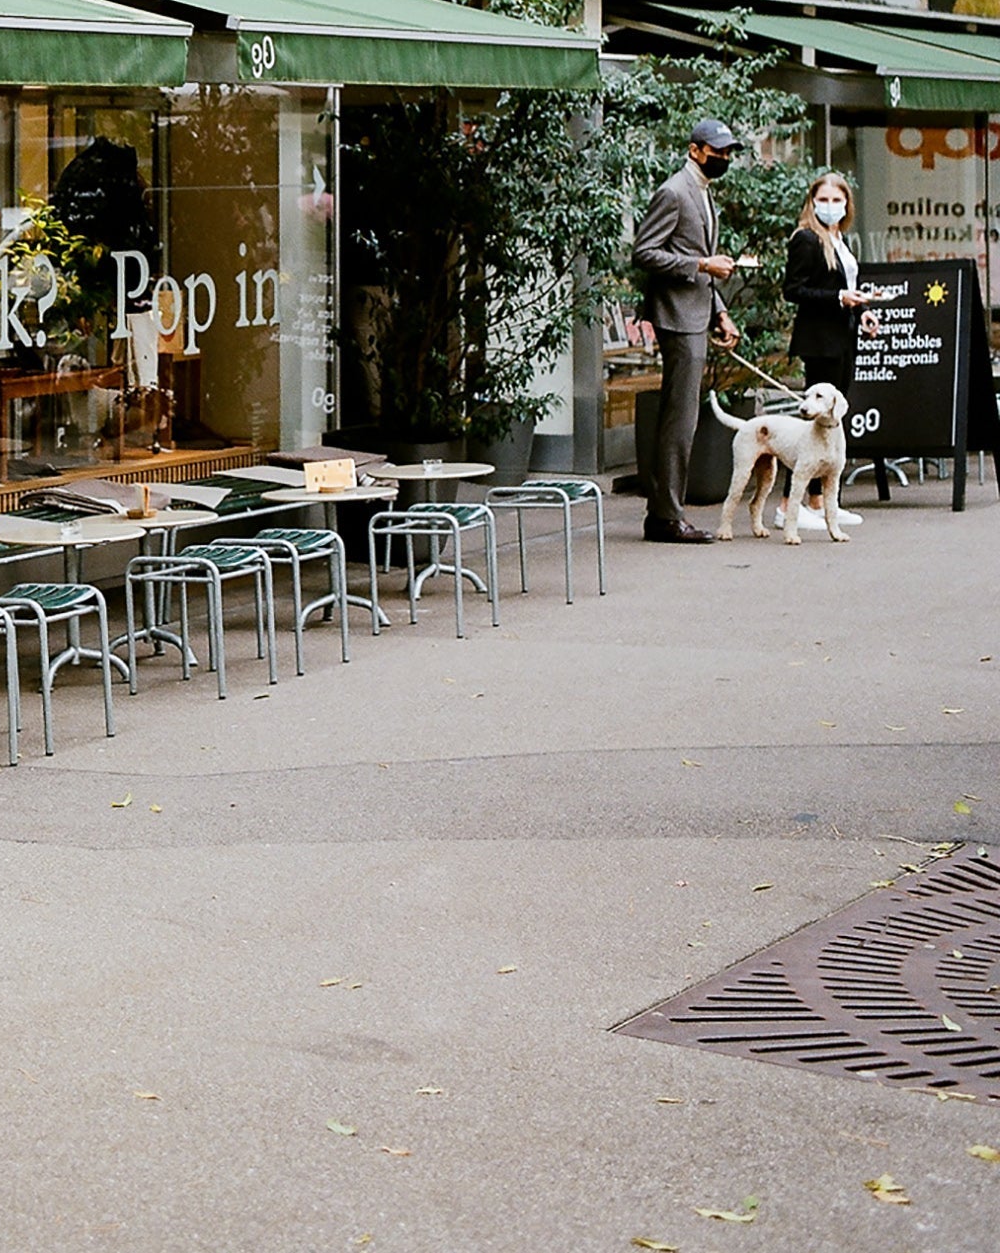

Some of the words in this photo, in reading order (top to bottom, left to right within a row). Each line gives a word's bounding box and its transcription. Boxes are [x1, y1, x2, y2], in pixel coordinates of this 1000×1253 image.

[110, 250, 217, 356] Pop
[235, 242, 282, 328] in
[884, 308, 916, 322] your
[857, 337, 889, 352] beer,
[891, 334, 942, 349] bubbles
[855, 351, 881, 366] and
[883, 349, 939, 368] negronis
[854, 366, 897, 381] inside.
